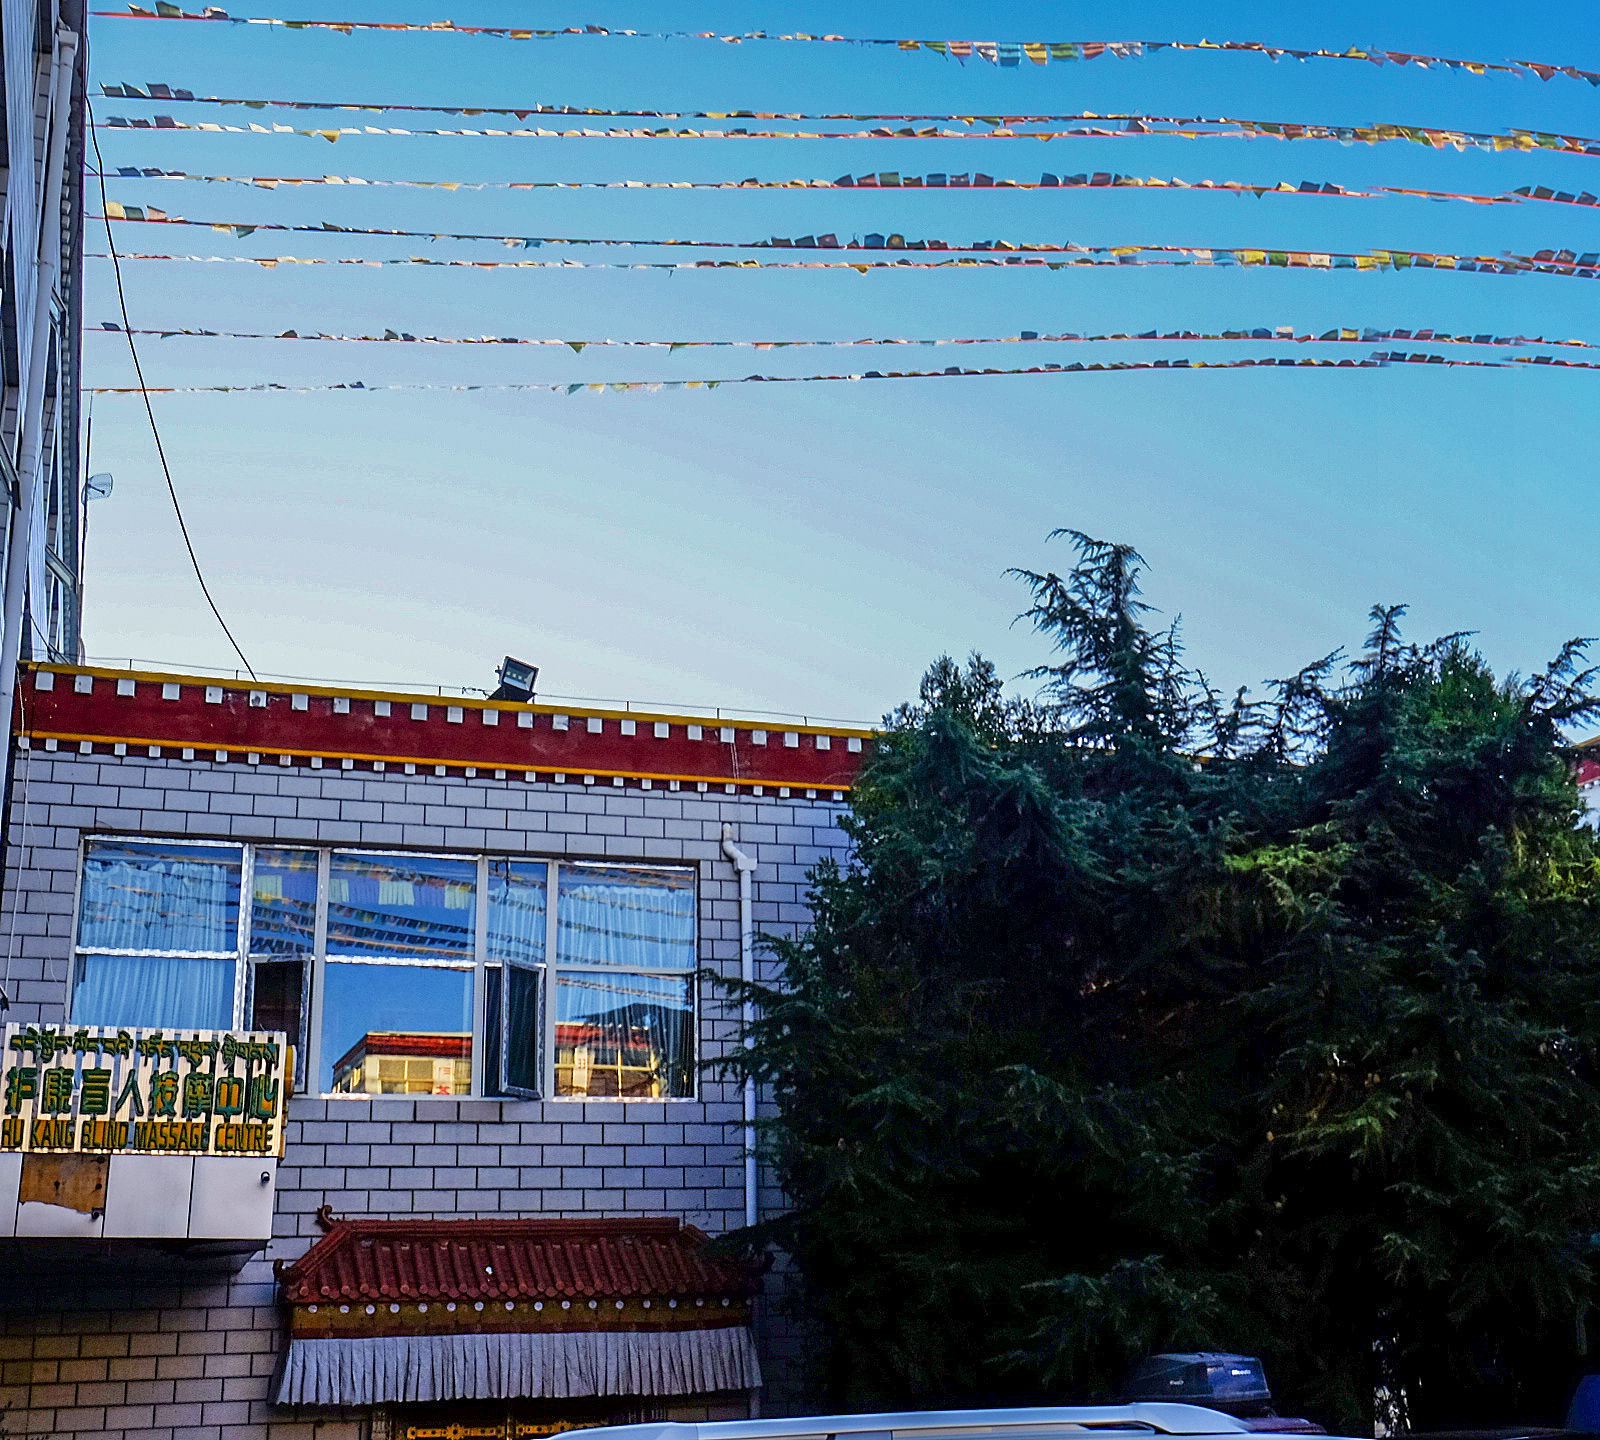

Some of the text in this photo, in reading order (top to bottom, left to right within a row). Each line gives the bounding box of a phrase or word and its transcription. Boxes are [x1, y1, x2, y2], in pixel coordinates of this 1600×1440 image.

[5, 1066, 279, 1118] 护康盲人按摩中心
[1, 1118, 273, 1151] HU KANG BLIND MASSAGE CENTRE
